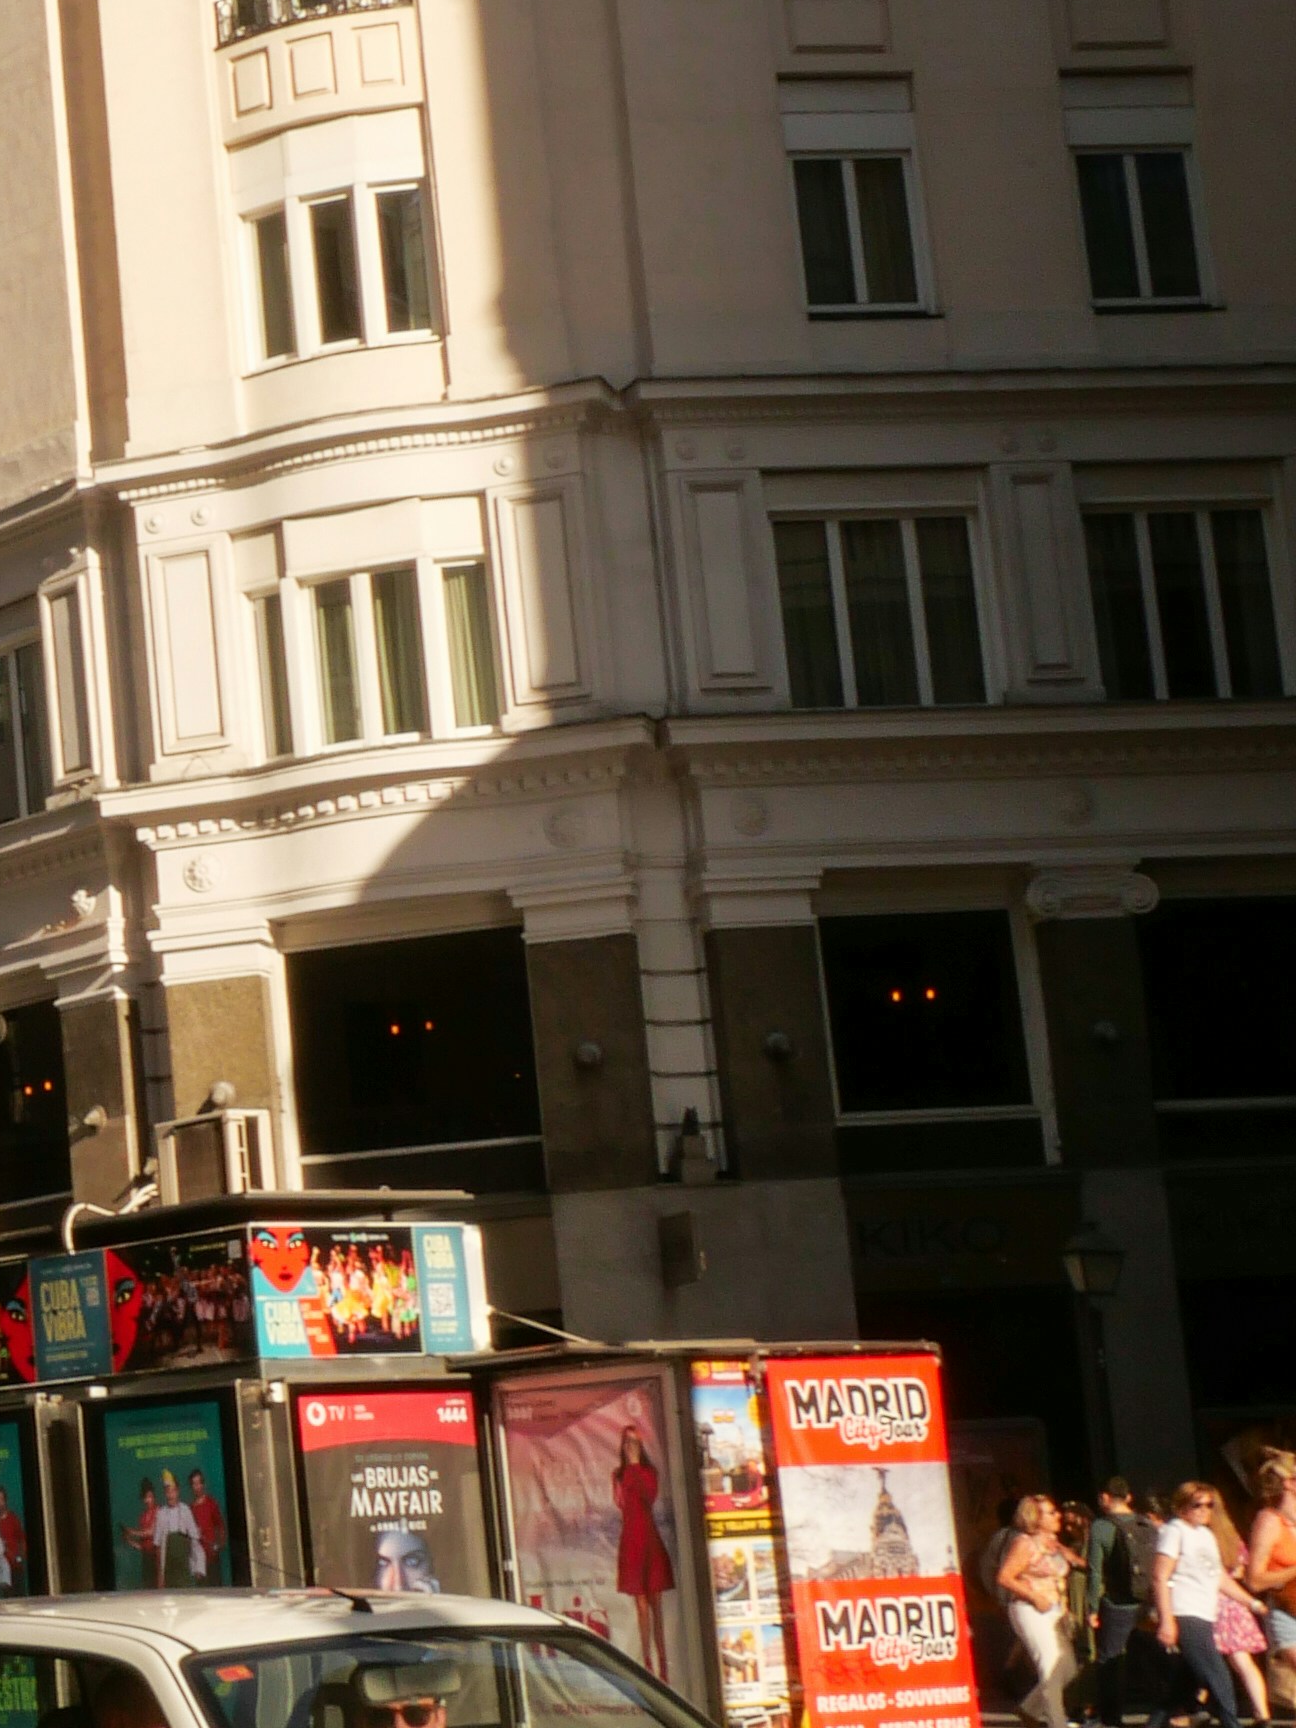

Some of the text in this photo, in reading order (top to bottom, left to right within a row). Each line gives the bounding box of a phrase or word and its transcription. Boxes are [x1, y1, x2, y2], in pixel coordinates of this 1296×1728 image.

[40, 1279, 81, 1313] CUBA
[42, 1309, 88, 1343] VIBRA
[264, 1301, 302, 1325] CUBA
[328, 1405, 345, 1421] TV
[437, 1407, 467, 1423] 1444
[786, 1379, 930, 1428] MADRID
[365, 1465, 430, 1489] BRUJAS
[350, 1486, 444, 1518] MAYFAIR
[816, 1595, 957, 1650] MADRID
[816, 1693, 887, 1713] REGALOS
[895, 1685, 971, 1709] SOUVENIRS
